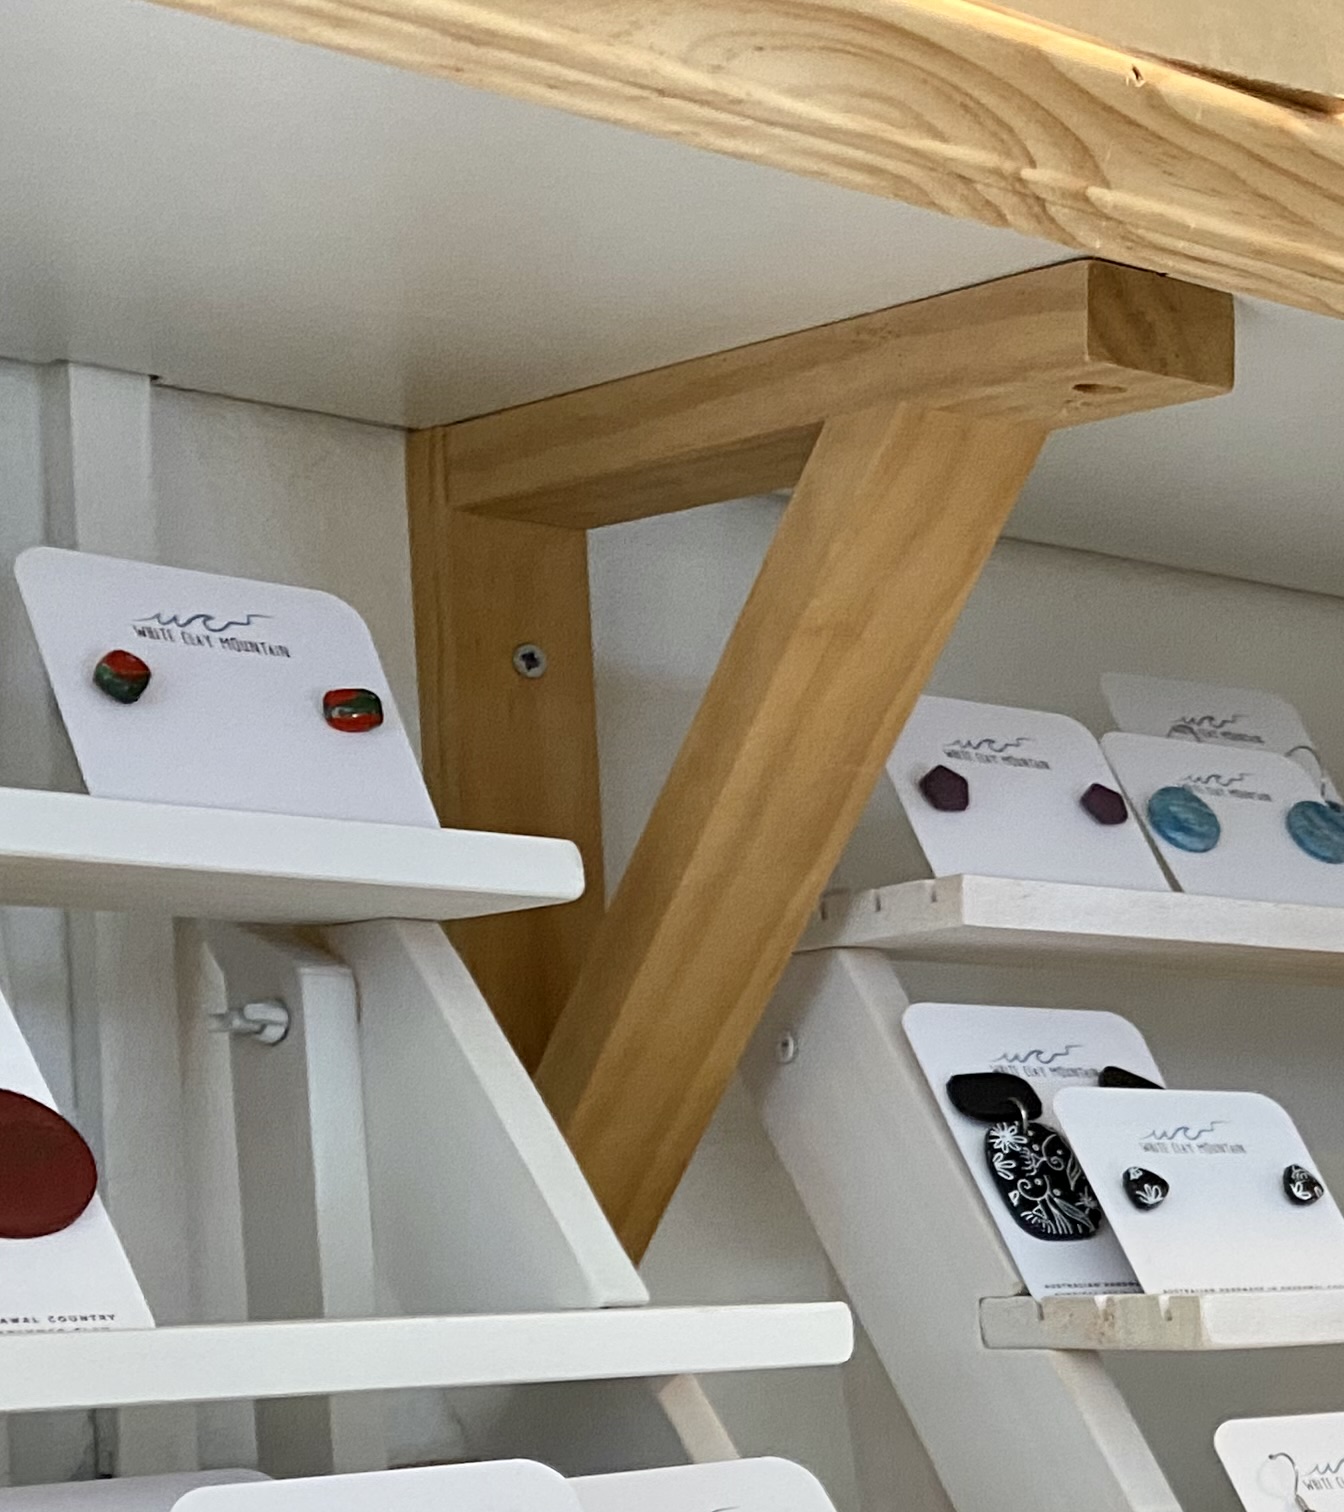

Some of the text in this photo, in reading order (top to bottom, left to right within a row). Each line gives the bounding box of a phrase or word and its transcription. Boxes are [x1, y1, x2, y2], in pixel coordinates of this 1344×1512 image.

[132, 625, 175, 643] WHITE
[219, 637, 291, 658] MOUNTAIN
[1302, 1476, 1334, 1491] WHITE
